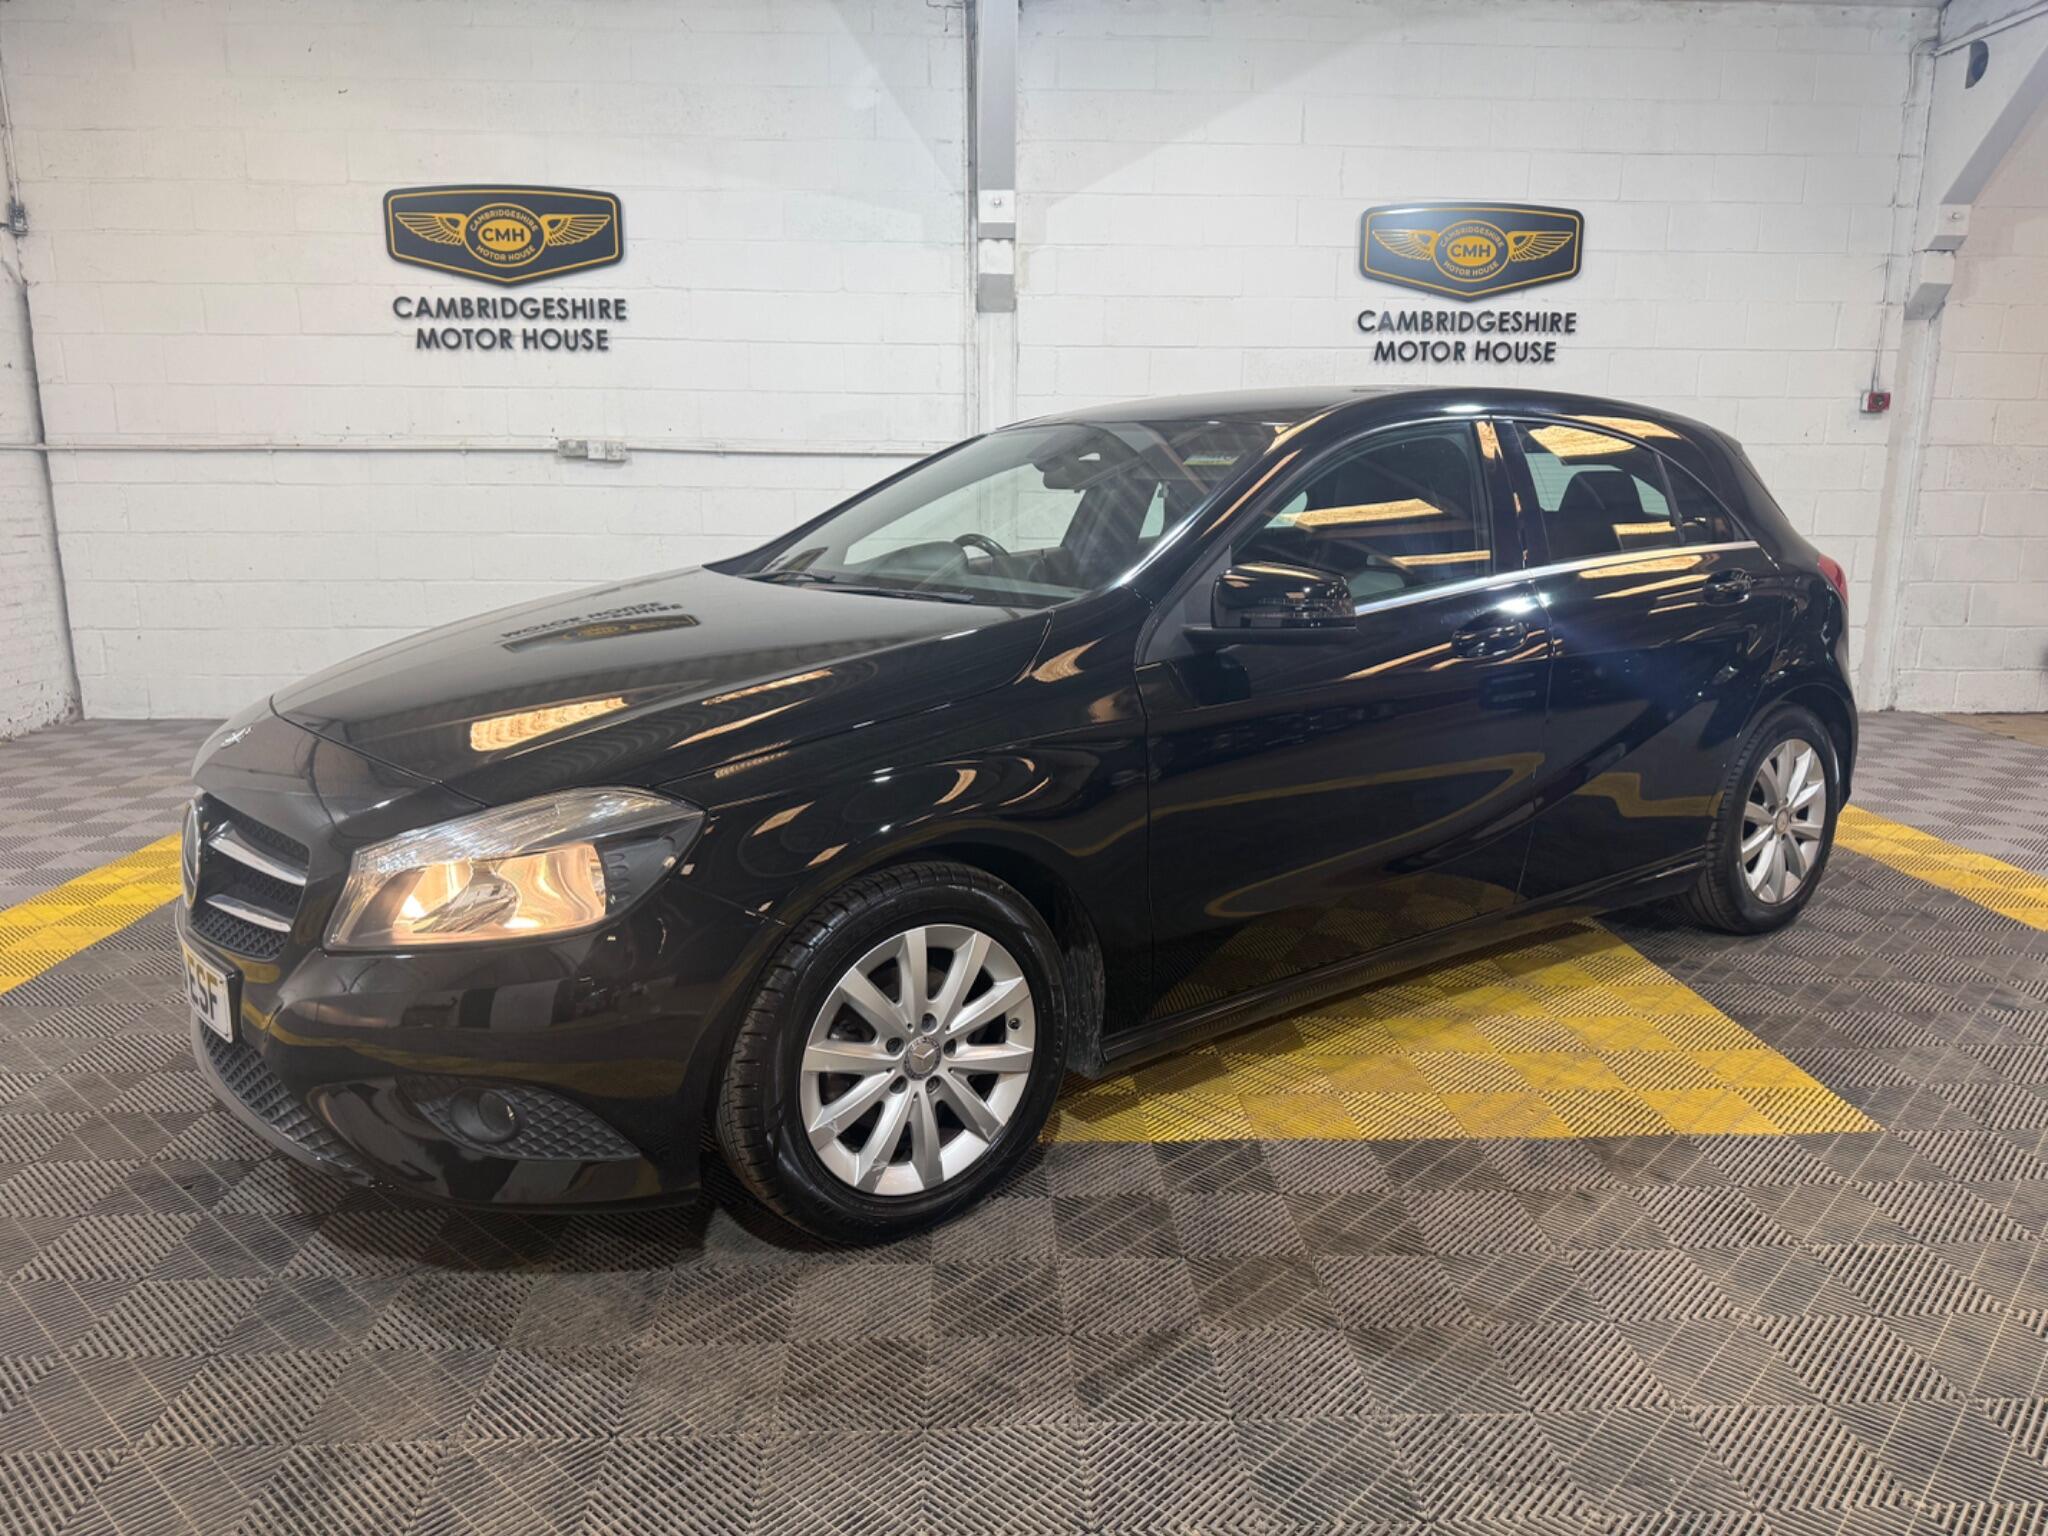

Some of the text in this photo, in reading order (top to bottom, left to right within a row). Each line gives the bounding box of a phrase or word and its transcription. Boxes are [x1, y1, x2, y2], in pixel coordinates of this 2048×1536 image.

[470, 209, 538, 231] CAMBRIDGESHIRE
[482, 228, 525, 242] CMH
[1440, 226, 1504, 247] CAMBRIDGESHIRE
[476, 245, 536, 262] MOTOR HOUSE
[1450, 244, 1491, 258] CMH
[1443, 260, 1499, 277] MOTOR HOUSE
[393, 297, 627, 320] CAMBRIDGESHIRE
[1357, 310, 1577, 333] CAMBRIDGESHIRE
[416, 328, 609, 351] MOTOR HOUSE
[1374, 341, 1556, 362] MOTOR HOUSE
[187, 953, 218, 1020] ESF
